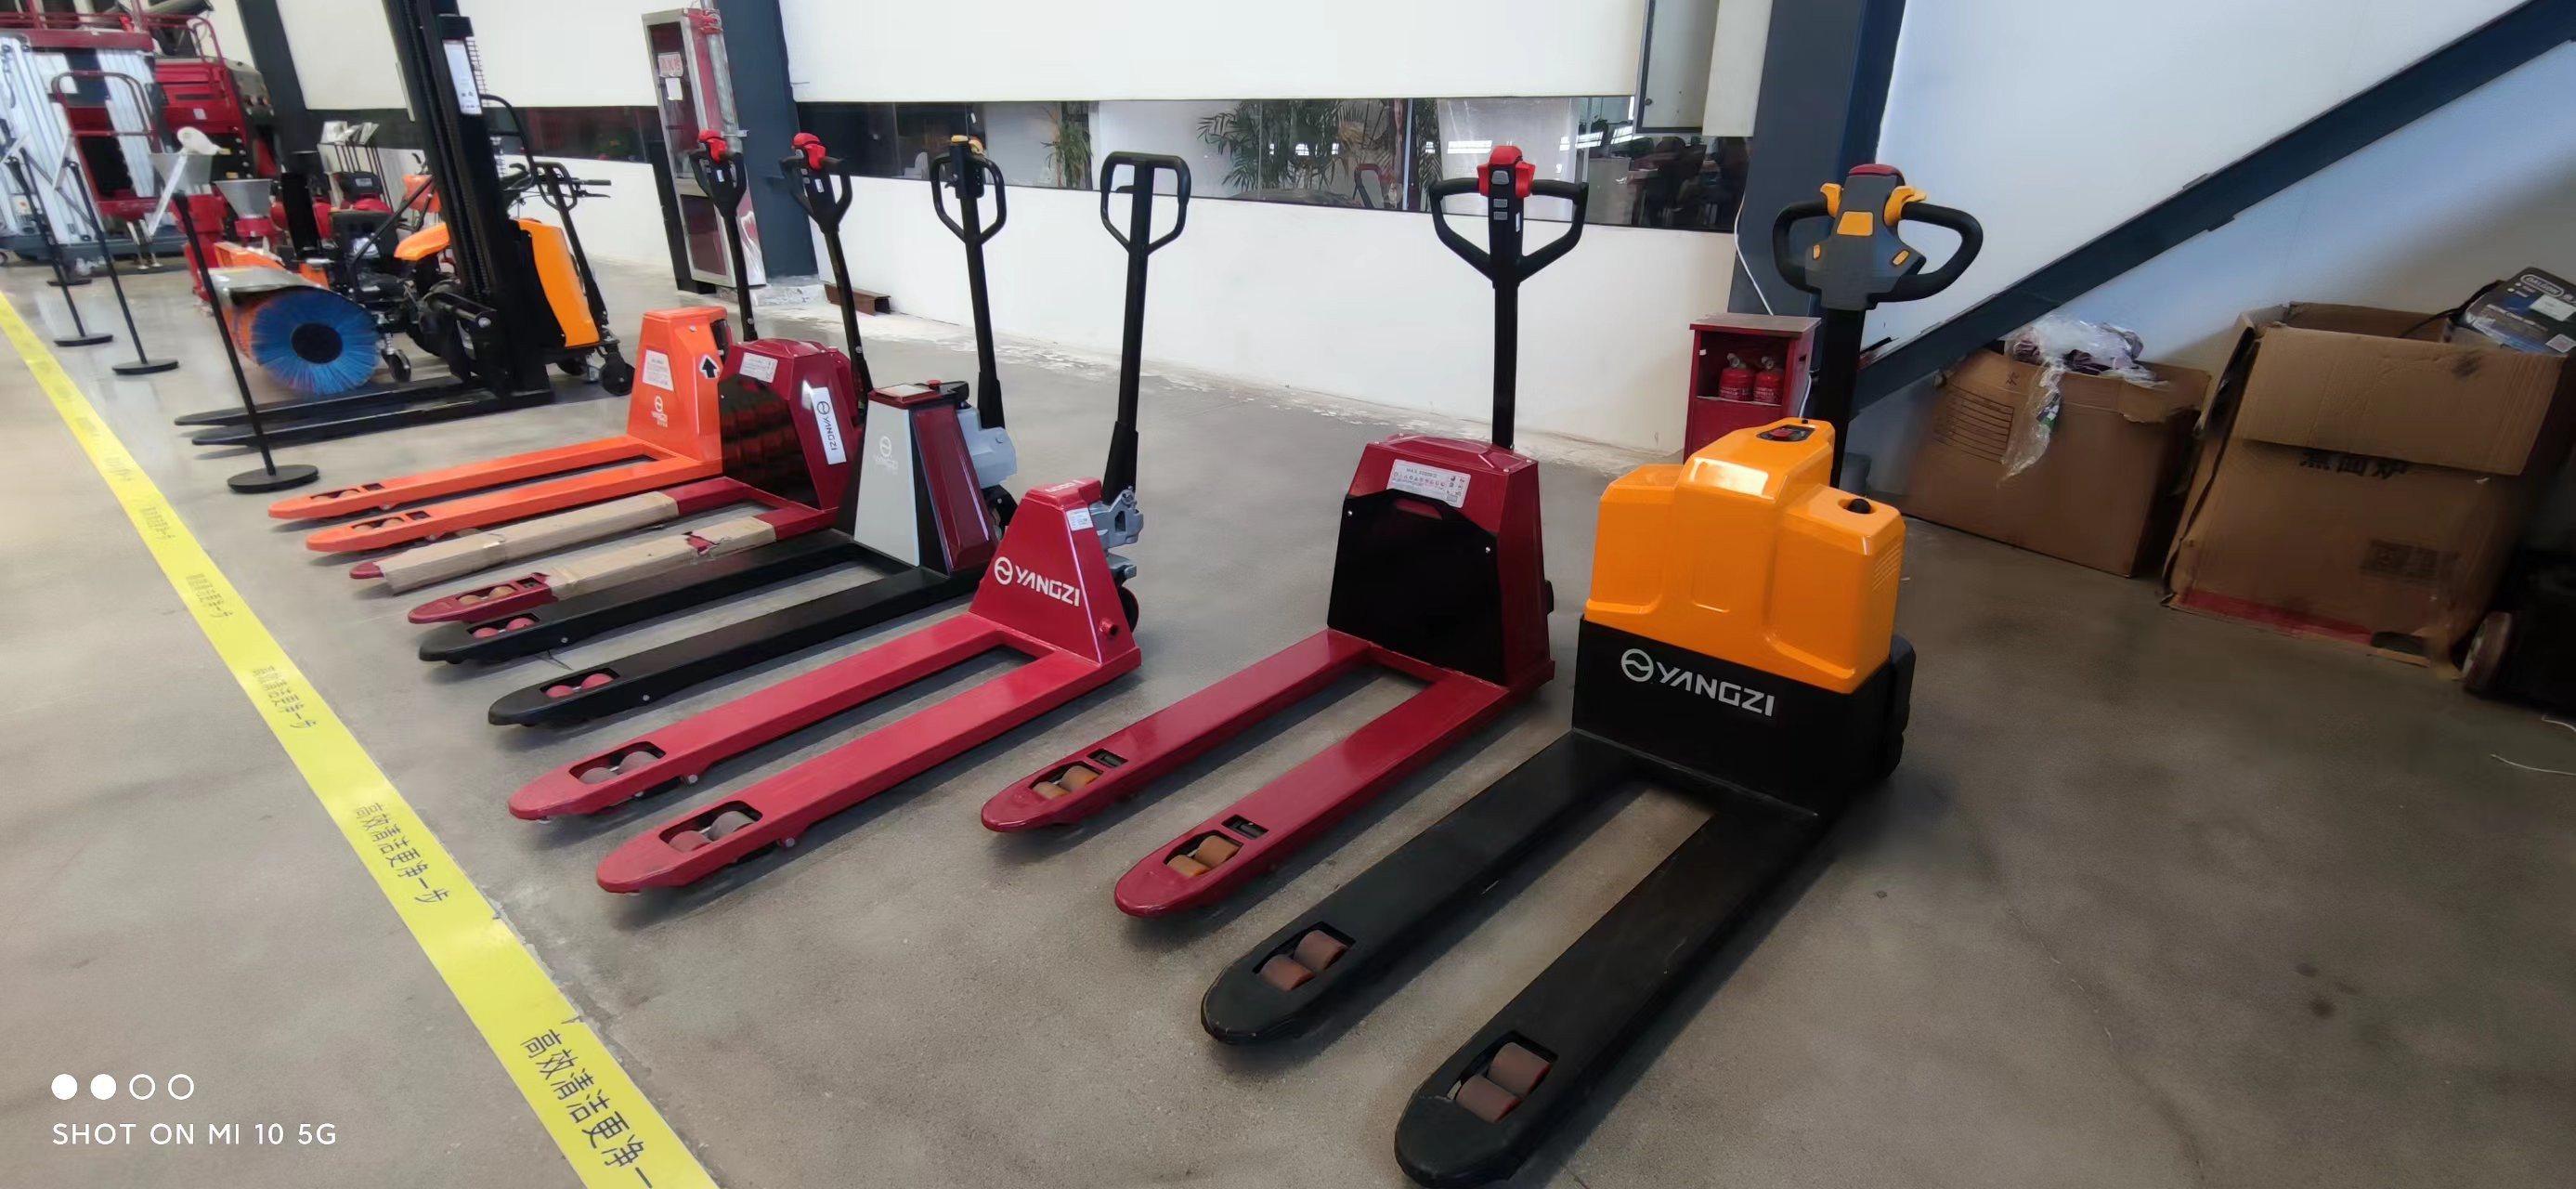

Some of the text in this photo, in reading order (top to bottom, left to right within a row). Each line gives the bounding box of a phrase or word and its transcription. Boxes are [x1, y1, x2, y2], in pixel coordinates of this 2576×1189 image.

[823, 415, 838, 451] YANGZI
[1015, 565, 1081, 608] YANGZI
[1656, 660, 1776, 717] YANGZI
[356, 802, 450, 903] 高效清洁更净一步
[519, 1028, 653, 1189] 高效清洁更净一
